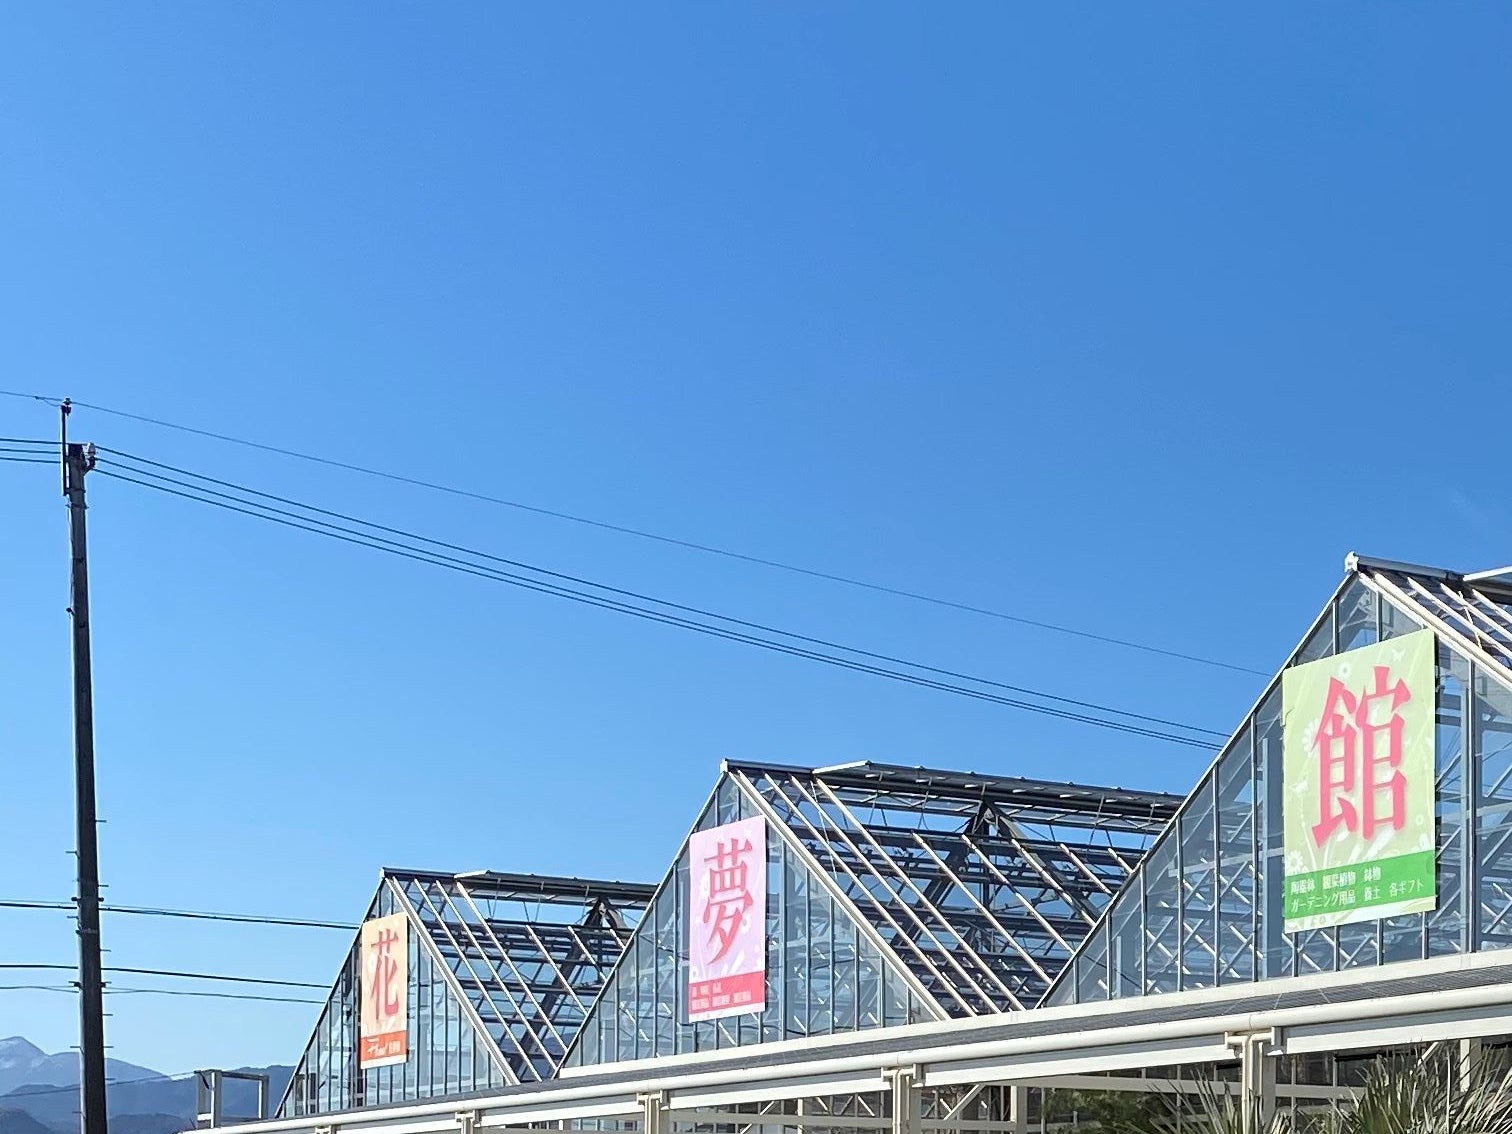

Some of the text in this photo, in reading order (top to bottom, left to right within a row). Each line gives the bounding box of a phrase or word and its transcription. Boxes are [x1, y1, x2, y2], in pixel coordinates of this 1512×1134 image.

[1312, 665, 1411, 848] 館
[703, 838, 753, 966] 夢
[1291, 891, 1356, 913] ガーデニング用品
[1389, 879, 1423, 897] 各ギフト
[370, 929, 399, 1020] 花
